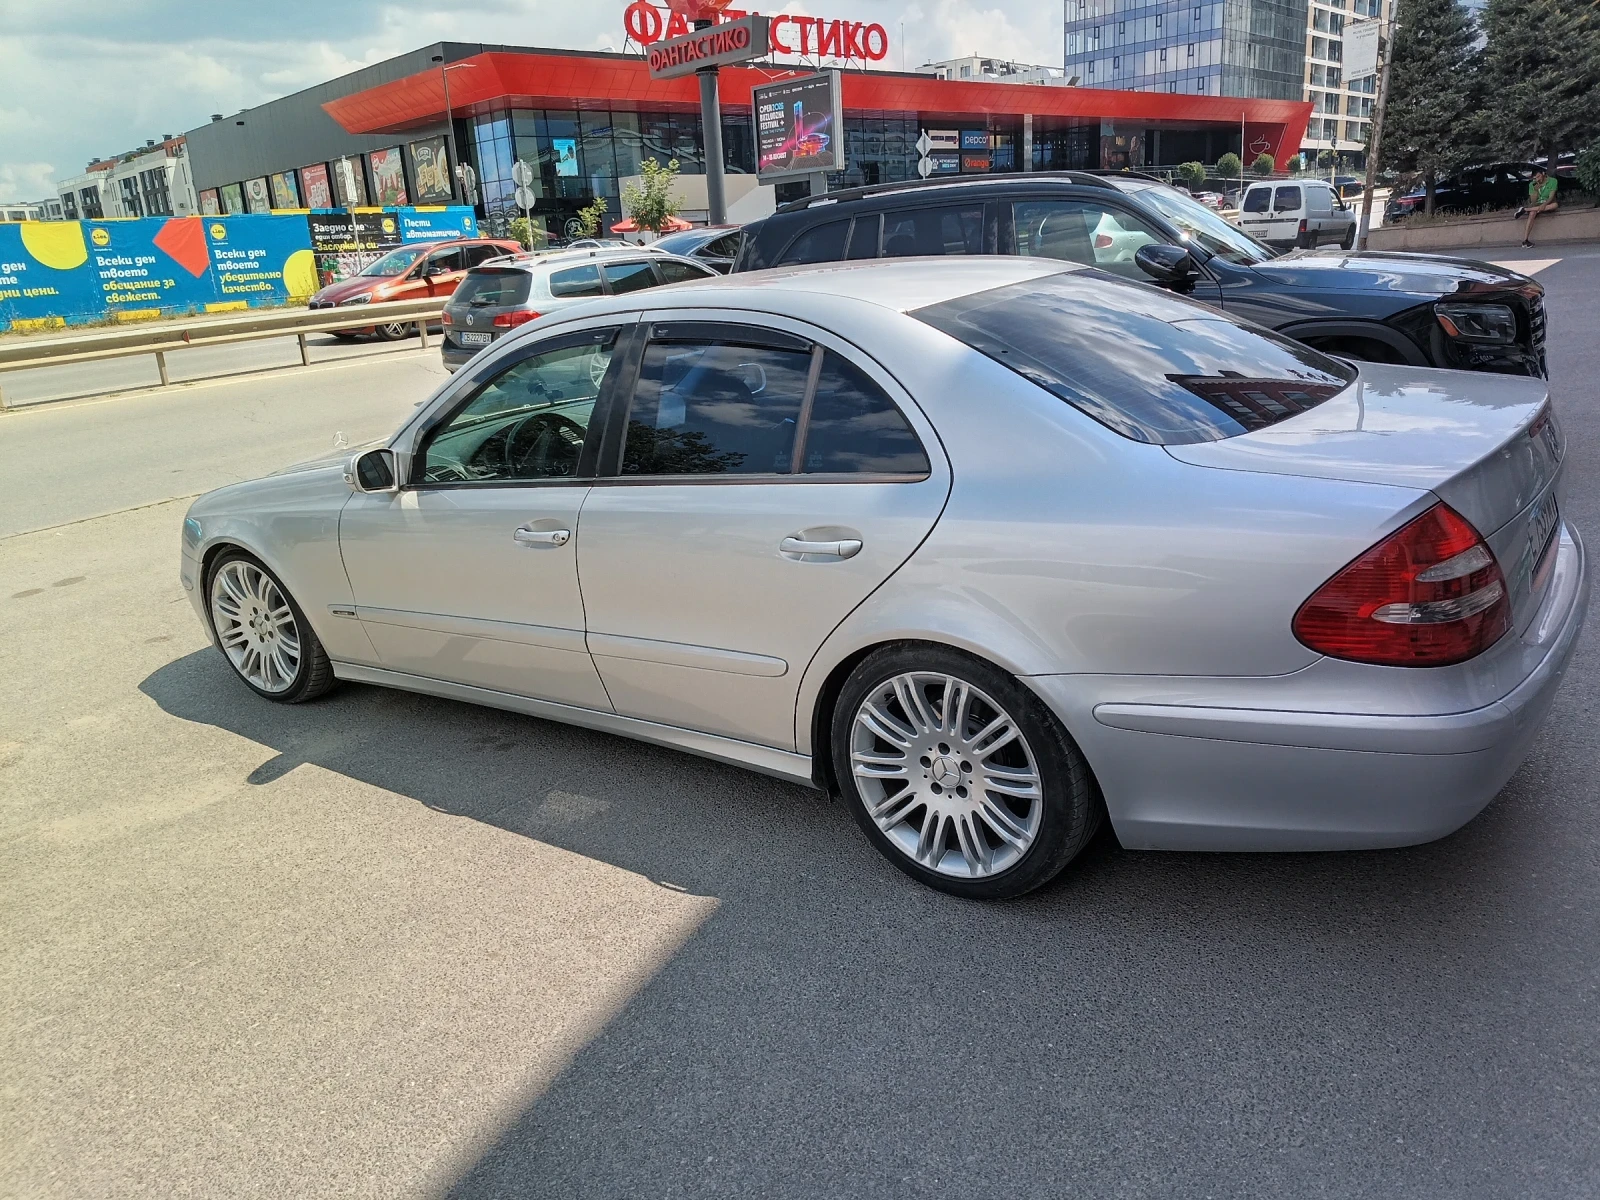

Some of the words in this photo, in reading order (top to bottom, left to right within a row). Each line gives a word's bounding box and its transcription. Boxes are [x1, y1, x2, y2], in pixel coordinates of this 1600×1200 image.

[650, 27, 749, 71] ФАНТАСТИКО
[965, 135, 987, 145] pepco
[404, 218, 431, 227] Пести
[312, 223, 346, 234] Заедно
[406, 229, 460, 239] автоматично
[214, 249, 246, 259] Всеки
[247, 249, 266, 260] ден
[96, 255, 133, 267] Всеки
[135, 256, 156, 267] ден
[216, 260, 259, 271] твоето
[1, 262, 26, 274] ден
[99, 268, 149, 279] твоето
[219, 271, 281, 284] убедително
[102, 280, 161, 291] обещание
[162, 278, 176, 290] за
[221, 282, 274, 293] качество.
[23, 287, 59, 298] цени.
[105, 292, 161, 303] свежест.
